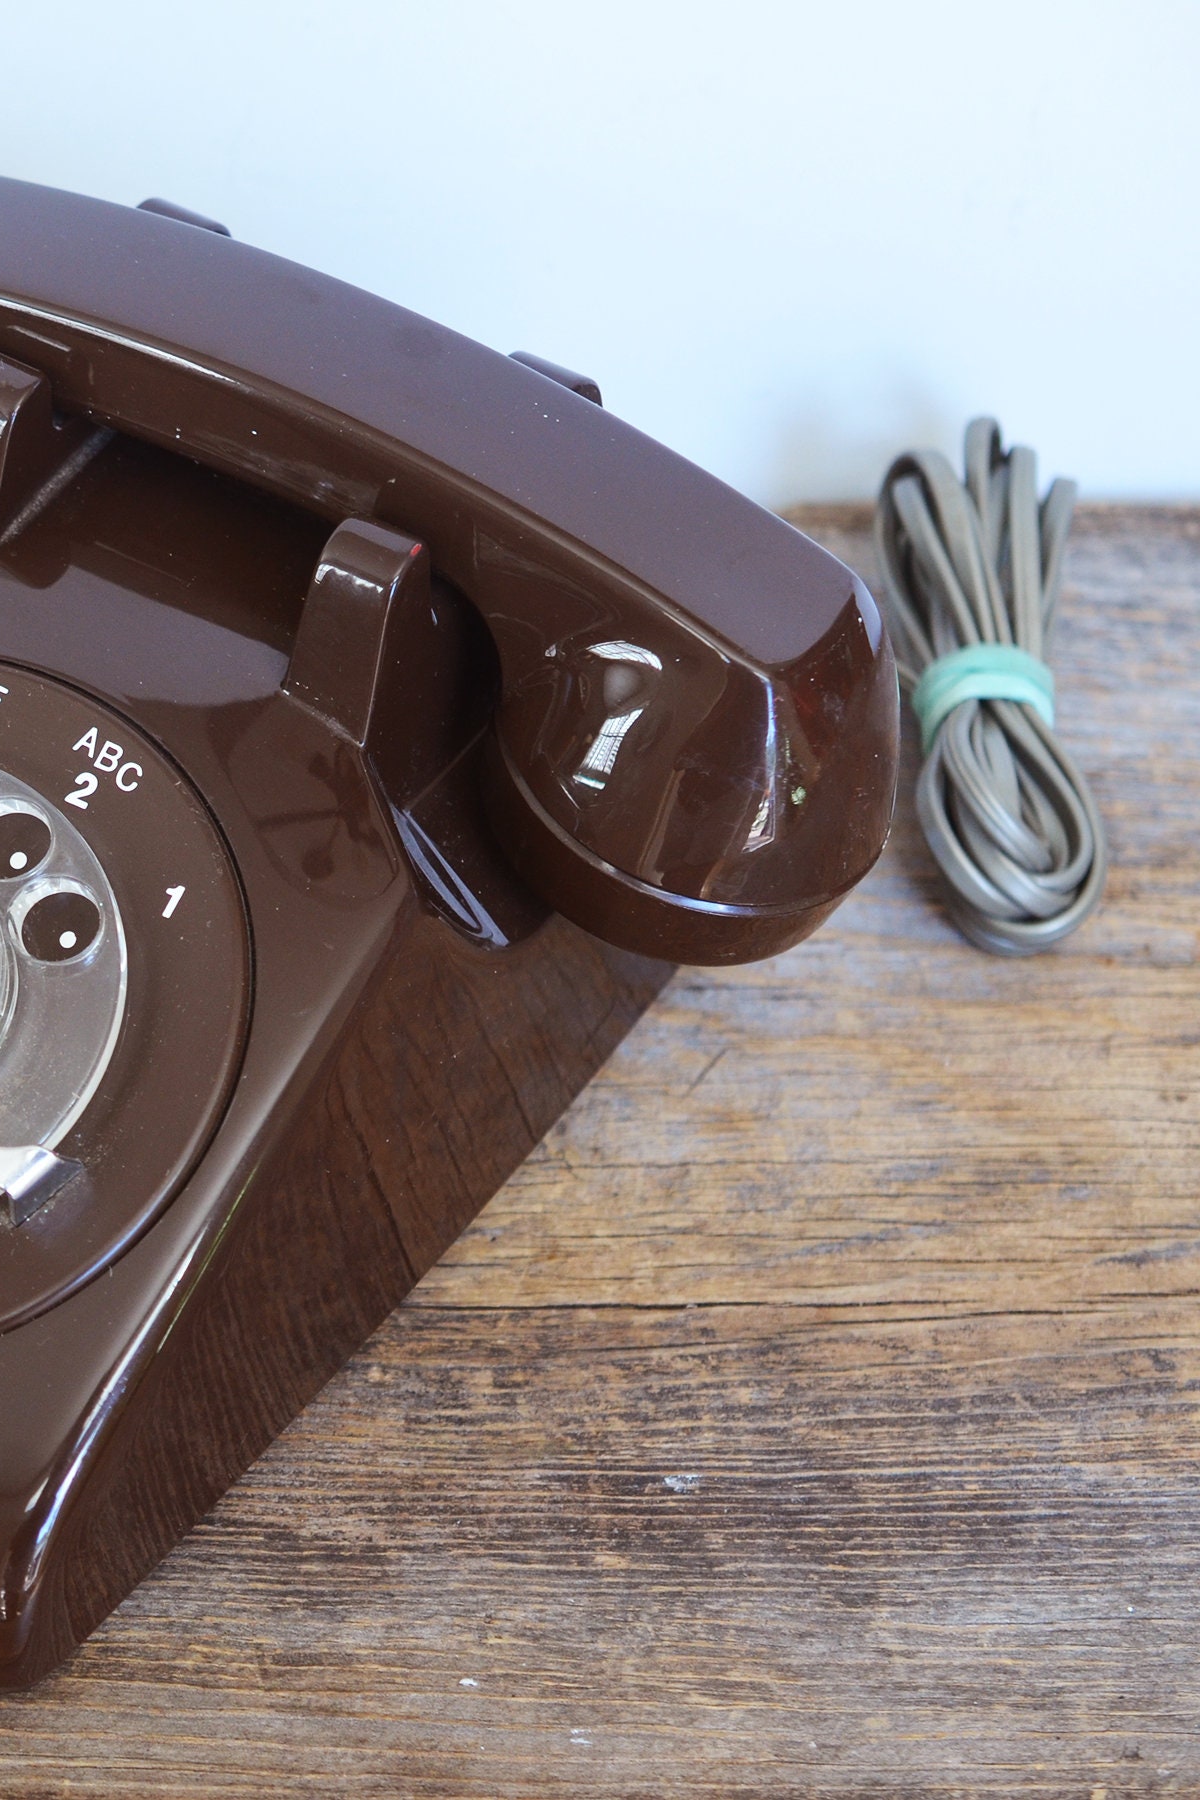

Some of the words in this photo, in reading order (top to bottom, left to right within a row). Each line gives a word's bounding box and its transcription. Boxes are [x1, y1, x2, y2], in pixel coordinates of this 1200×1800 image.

[72, 727, 143, 792] ABC
[64, 772, 99, 810] 2
[162, 885, 186, 919] 1
